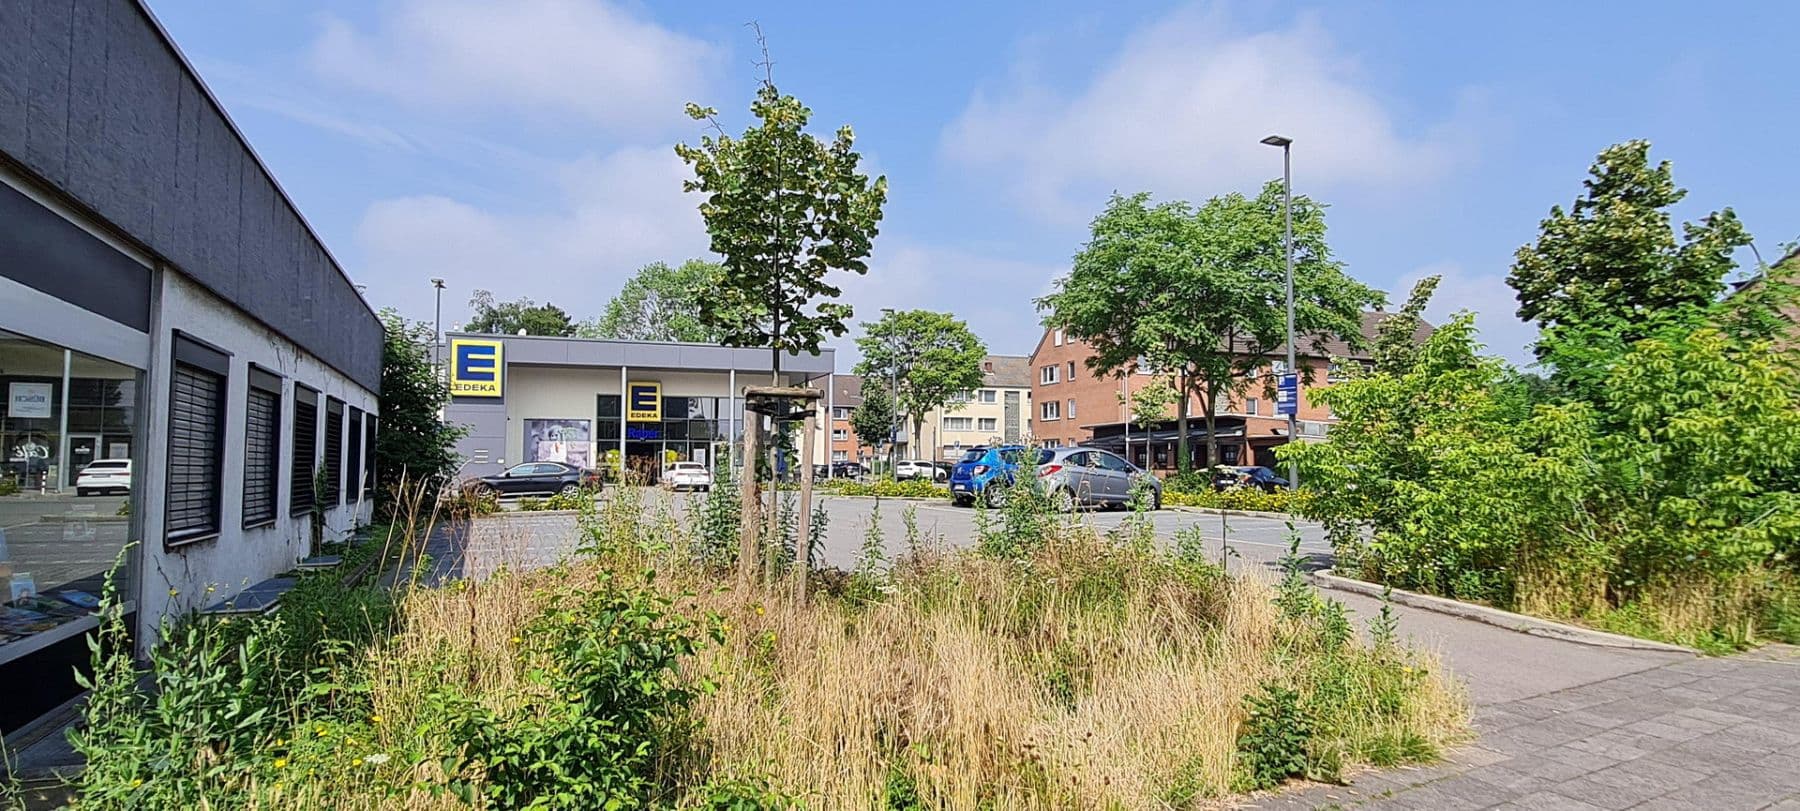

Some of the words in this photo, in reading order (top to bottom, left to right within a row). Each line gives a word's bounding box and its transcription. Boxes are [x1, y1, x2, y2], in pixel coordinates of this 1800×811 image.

[456, 344, 495, 381] E
[455, 383, 496, 391] EDEKA
[631, 385, 656, 411] E
